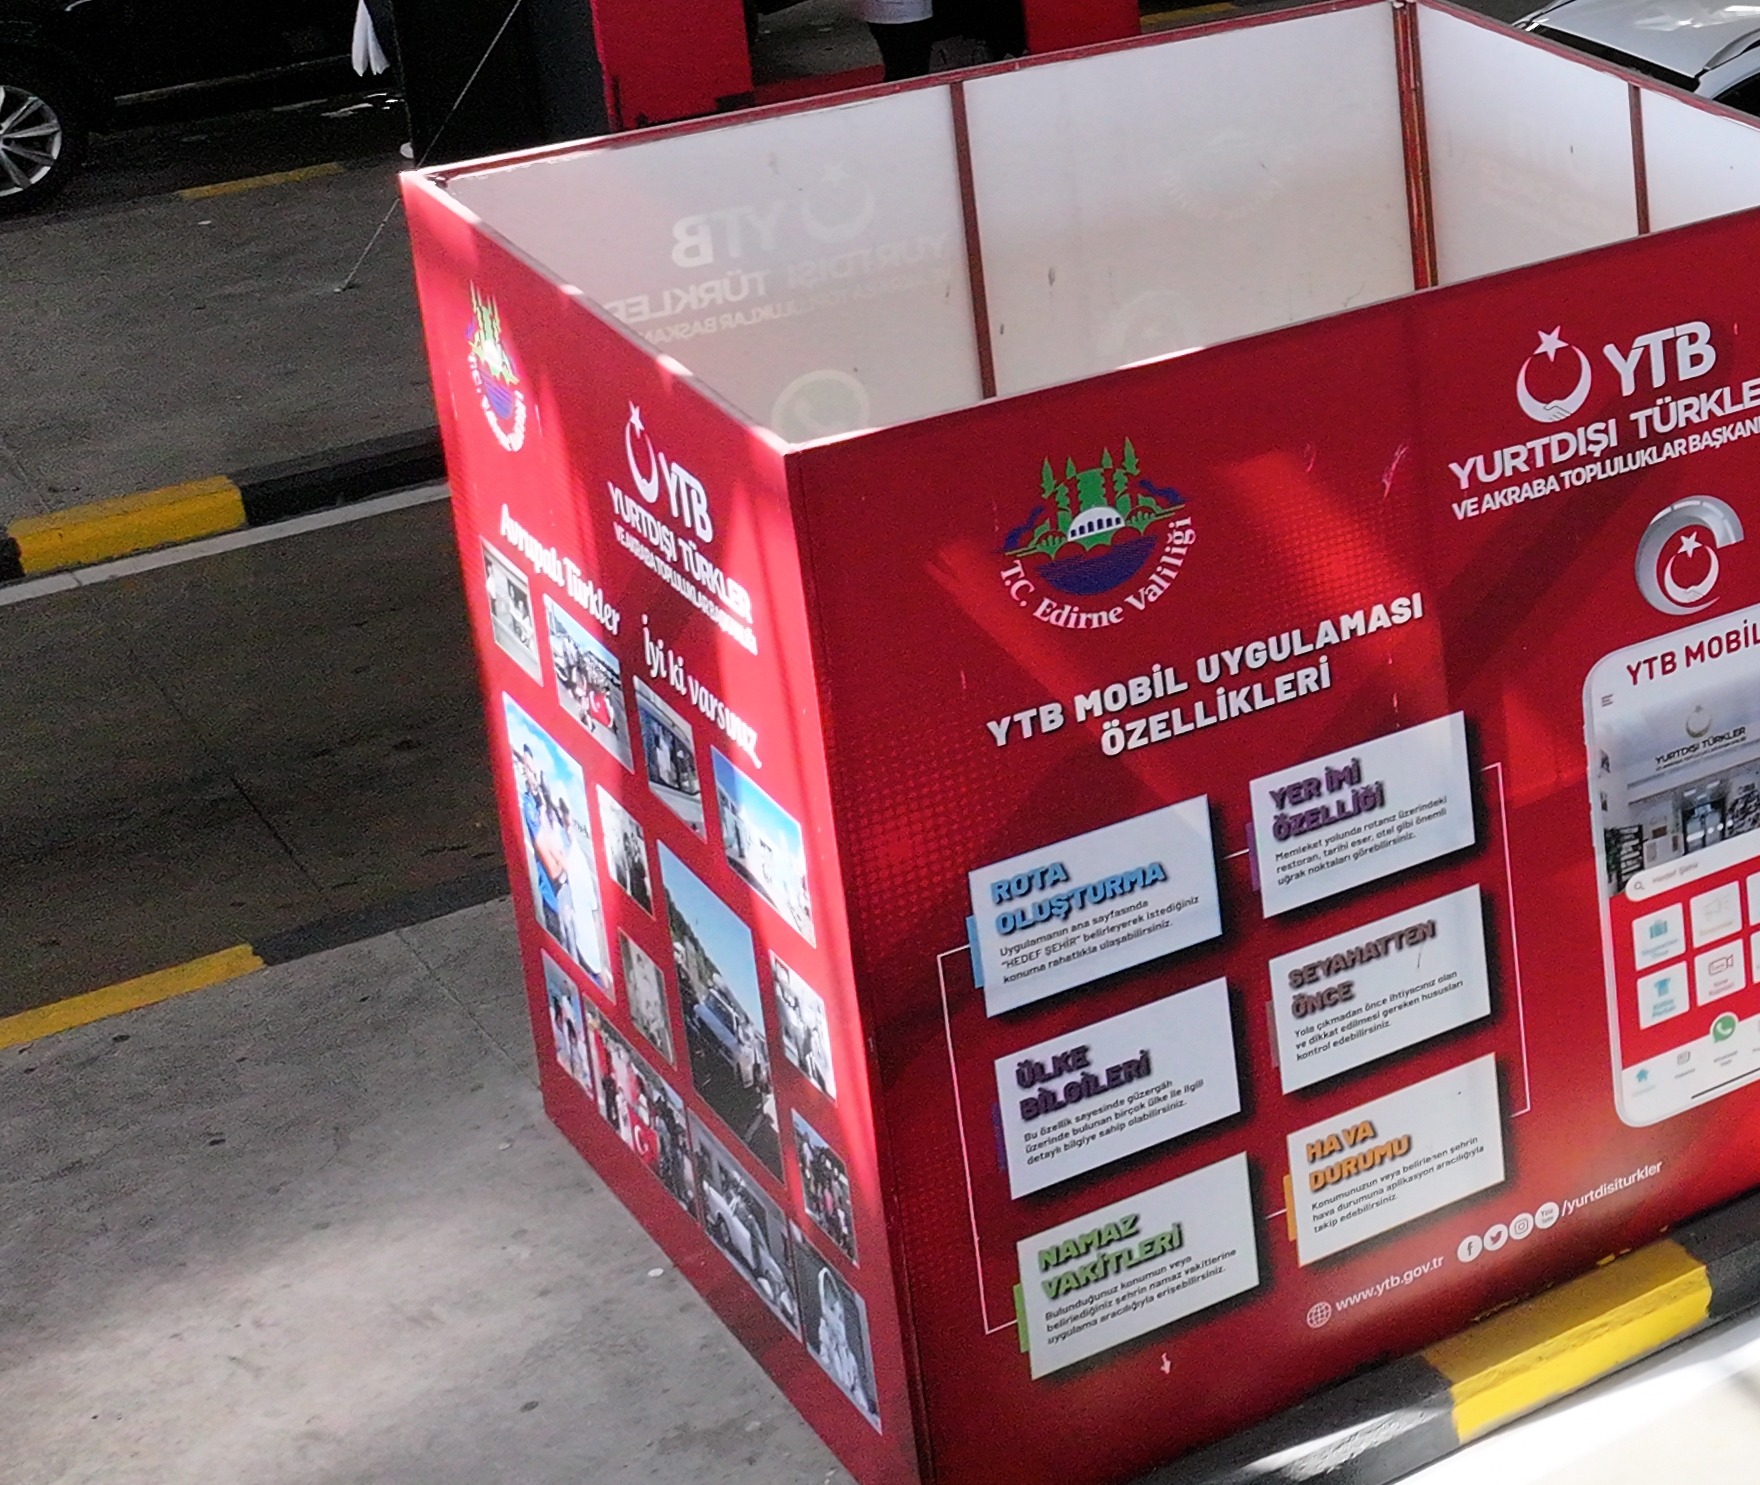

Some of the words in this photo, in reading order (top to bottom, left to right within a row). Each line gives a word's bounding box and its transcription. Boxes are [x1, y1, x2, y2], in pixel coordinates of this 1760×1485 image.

[1603, 320, 1717, 397] YTB
[1448, 418, 1619, 491] YURTDIŞI
[1452, 496, 1480, 520] VE
[1480, 476, 1560, 515] AKRABA
[1560, 441, 1687, 490] TOPLULUKLAR
[658, 452, 714, 543] YTB
[501, 503, 565, 588] Avrupalı
[563, 556, 620, 635] Türkler
[607, 480, 678, 562] YURTDIŞI
[677, 537, 754, 624] TÜRKLER
[1001, 559, 1035, 607] T.C.
[1032, 595, 1124, 629] Edirne
[1124, 516, 1197, 612] Valiliği
[642, 614, 667, 679] İyi
[668, 649, 687, 695] ki
[986, 701, 1065, 748] YTB
[1074, 662, 1188, 722] MOBİL
[1196, 591, 1425, 684] UYGULAMASI
[1625, 649, 1678, 686] YTB
[1101, 655, 1332, 757] ÖZELLİKLERİ
[1269, 776, 1323, 811] YER
[1324, 757, 1362, 793] İMİ
[1272, 780, 1386, 842] ÖZELLİĞİ
[1275, 838, 1323, 862] Memleket
[1324, 825, 1362, 848] yolunda
[1399, 795, 1448, 819] üzerindeki
[1323, 841, 1350, 859] tarihi
[1375, 826, 1395, 840] otel
[1396, 818, 1414, 834] gibi
[1414, 807, 1448, 826] önemli
[990, 861, 1069, 905] ROTA
[995, 861, 1168, 937] OLUŞTURMA
[1277, 869, 1306, 887] uğrak
[1000, 926, 1069, 959] Uygulamanın
[1070, 920, 1091, 934] ana
[1092, 899, 1150, 927] sayfasında
[1083, 911, 1146, 944] belirleyerek
[1146, 895, 1199, 921] istediğiniz
[1003, 964, 1046, 985] konuma
[1287, 919, 1438, 990] SEYAHATTEN
[1291, 980, 1357, 1020] ÖNCE
[1294, 1024, 1315, 1038] Yola
[1316, 1007, 1364, 1032] çıkmadan
[1364, 998, 1388, 1013] önce
[1437, 970, 1458, 984] olan
[1295, 1040, 1307, 1050] ve
[1308, 1027, 1339, 1046] dikkat
[1340, 1011, 1381, 1033] edilmesi
[1382, 998, 1420, 1019] gereken
[1421, 981, 1464, 1001] hususları
[1015, 1044, 1090, 1089] ÜLKE
[1296, 1043, 1331, 1062] kontrol
[1019, 1048, 1152, 1122] BİLGİLERİ
[1023, 1130, 1038, 1143] Bu
[1040, 1117, 1073, 1137] özellik
[1074, 1098, 1126, 1125] sayesinde
[1025, 1129, 1071, 1154] üzerinde
[1072, 1116, 1113, 1136] bulunan
[1113, 1101, 1146, 1123] birçok
[1147, 1092, 1169, 1108] ülke
[1063, 1133, 1098, 1155] bilgiye
[1098, 1121, 1127, 1140] sahip
[1308, 1133, 1412, 1194] DURUMU
[1311, 1178, 1379, 1212] Konumunuzun
[1379, 1169, 1402, 1185] veya
[1449, 1136, 1479, 1157] şehrin
[1560, 1161, 1664, 1217] /yurtdisiturkler
[1312, 1208, 1336, 1223] hava
[1336, 1187, 1386, 1213] durumuna
[1385, 1167, 1435, 1196] aplikasyon
[1313, 1217, 1339, 1234] takip
[1038, 1213, 1139, 1272] NAMAZ
[1041, 1221, 1184, 1300] VAKİTLERİ
[1045, 1284, 1119, 1321] Bulunduğunuz
[1120, 1265, 1168, 1292] konumun
[1169, 1256, 1193, 1272] veya
[1114, 1285, 1148, 1307] şehrin
[1148, 1273, 1183, 1292] namaz
[1184, 1249, 1237, 1276] vakitlerine
[1335, 1255, 1445, 1312] www.ytb.gov.tr
[1047, 1319, 1099, 1346] uygulama
